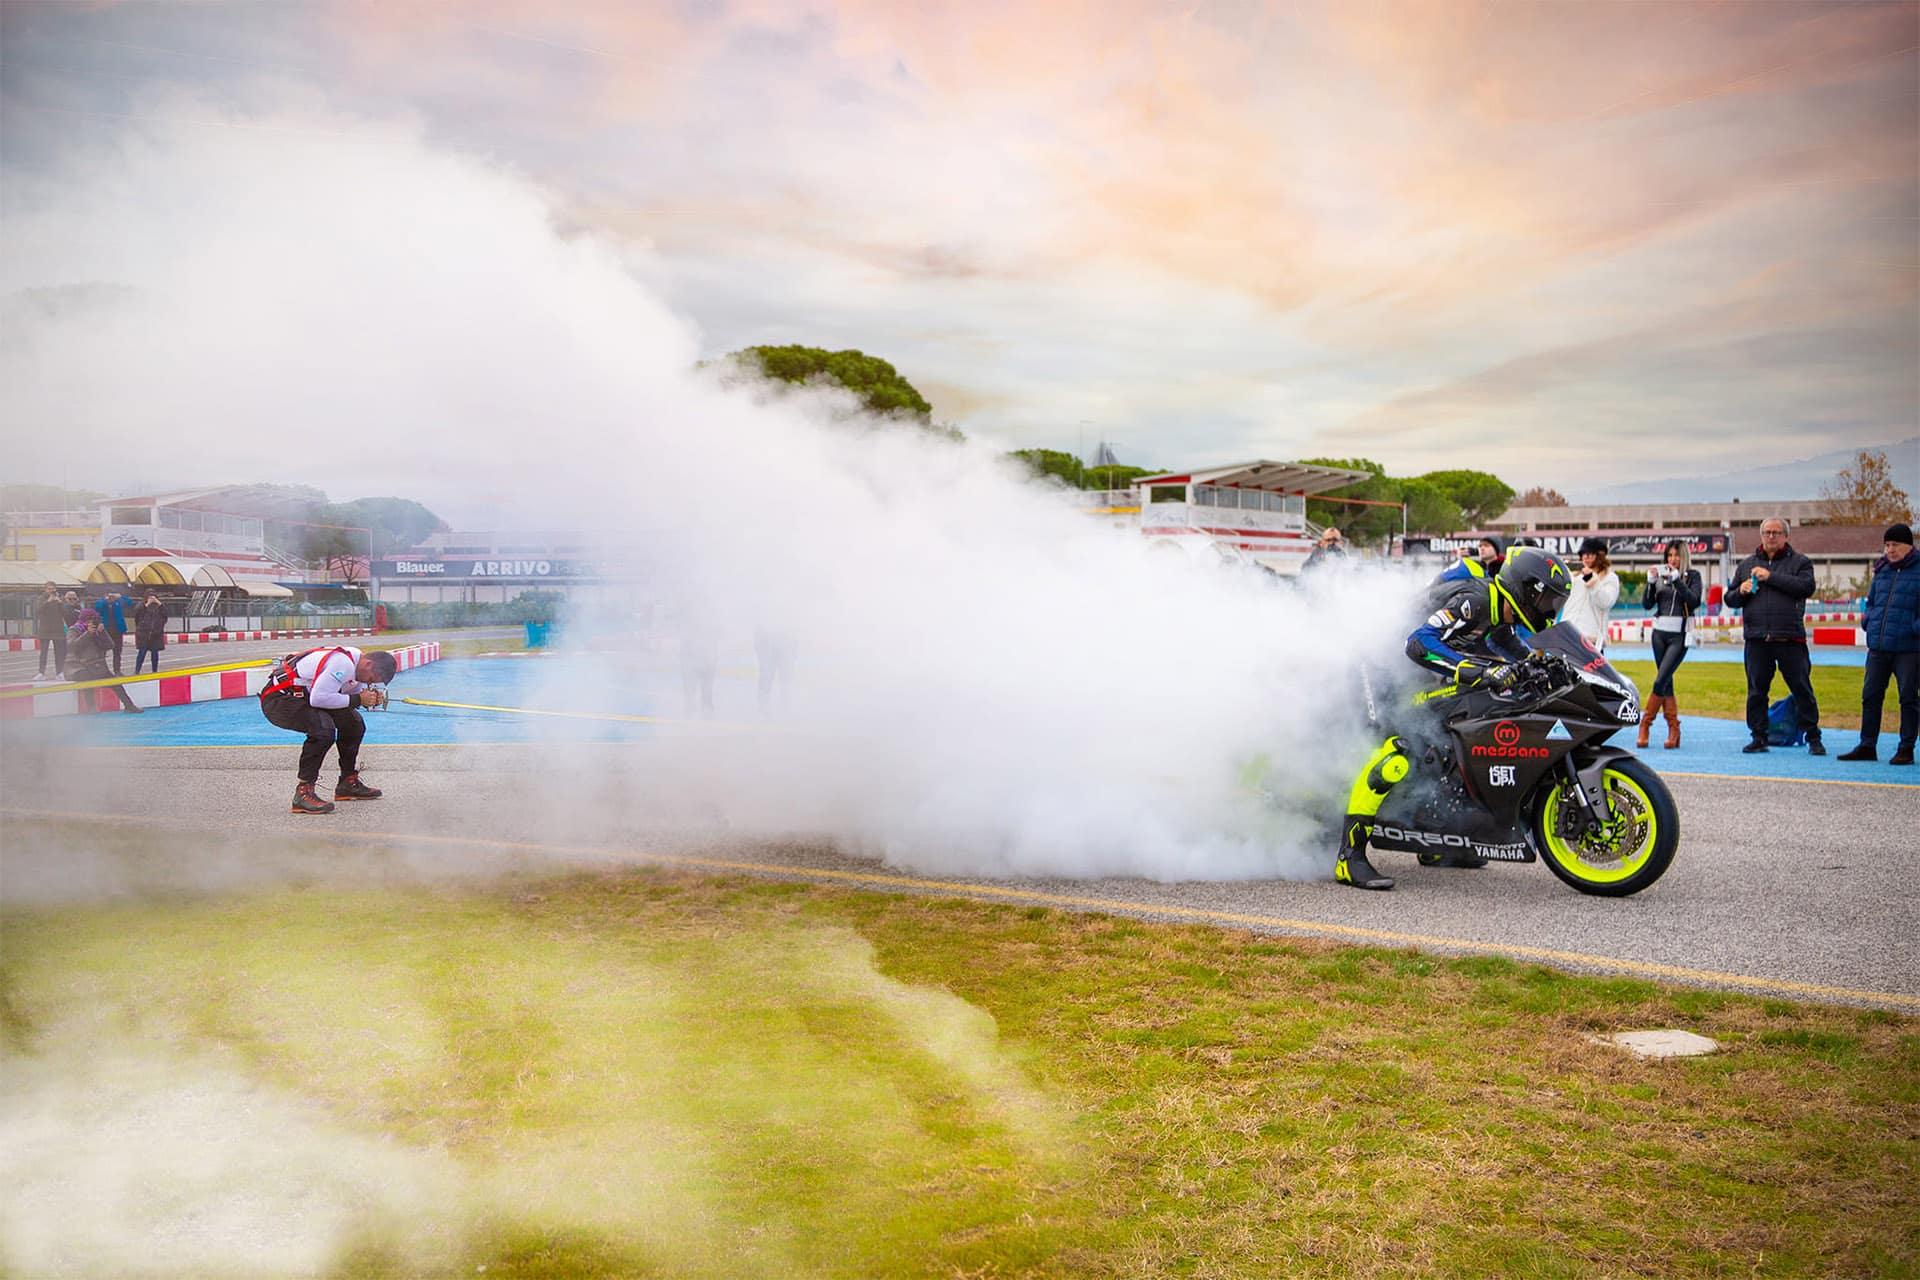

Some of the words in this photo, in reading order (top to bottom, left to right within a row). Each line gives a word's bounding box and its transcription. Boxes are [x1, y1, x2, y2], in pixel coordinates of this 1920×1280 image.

[471, 561, 550, 576] ARRIVO
[1471, 745, 1549, 758] messana
[1475, 845, 1525, 860] YAMAHA
